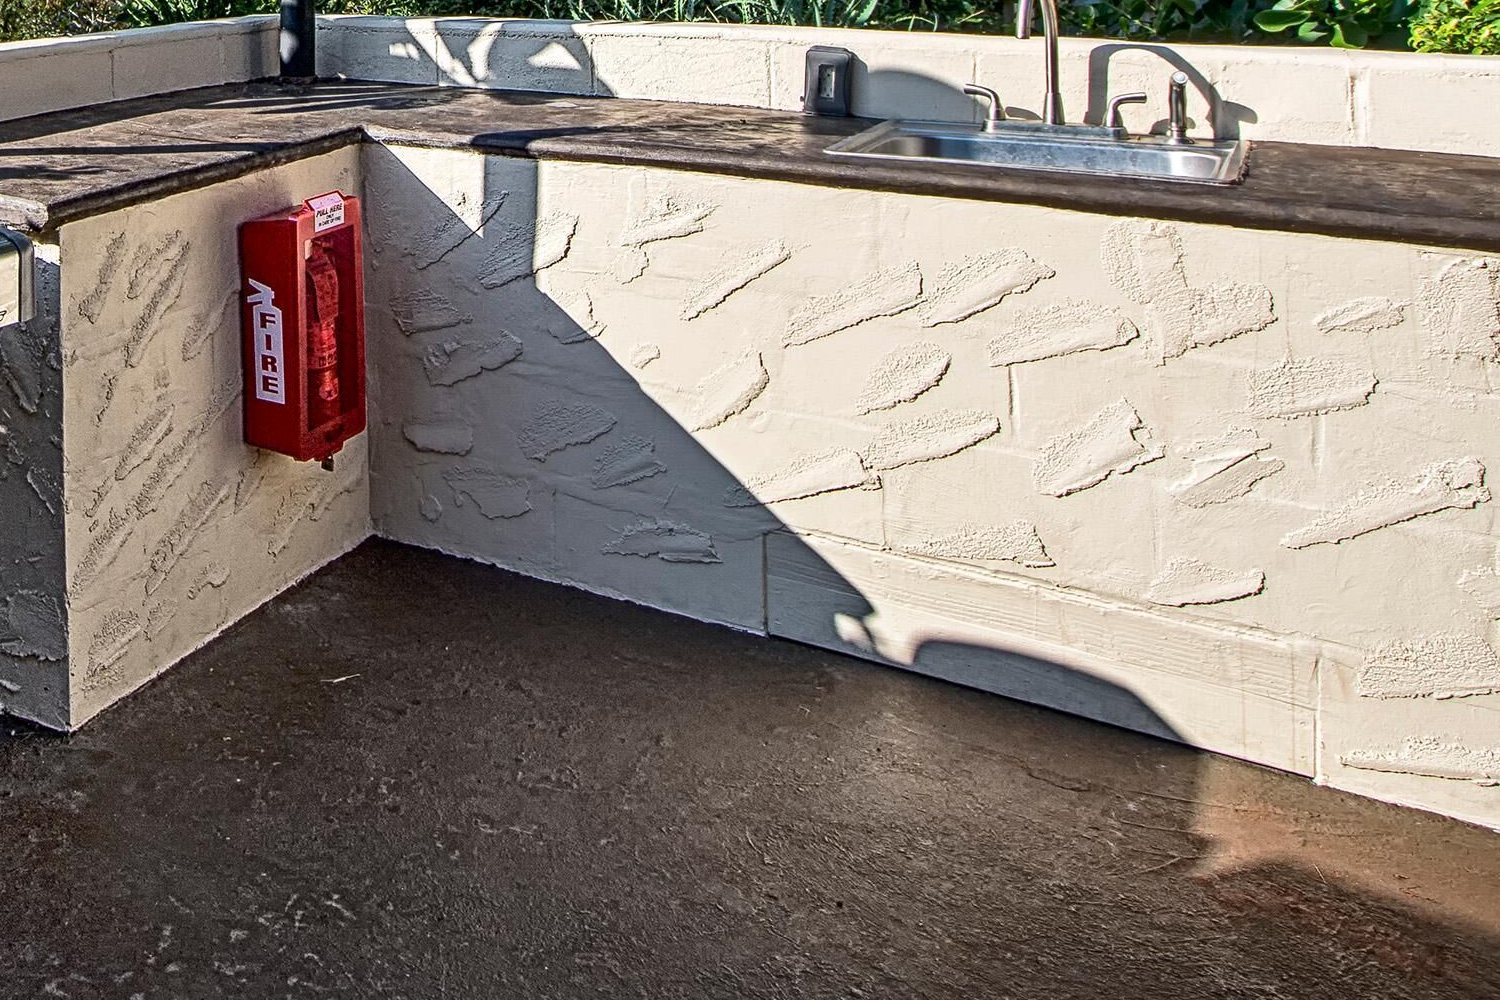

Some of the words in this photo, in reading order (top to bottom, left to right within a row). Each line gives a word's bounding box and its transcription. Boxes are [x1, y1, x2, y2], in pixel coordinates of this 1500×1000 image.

[316, 208, 328, 217] PULL
[330, 203, 342, 213] HERE
[260, 312, 278, 394] FIRE
